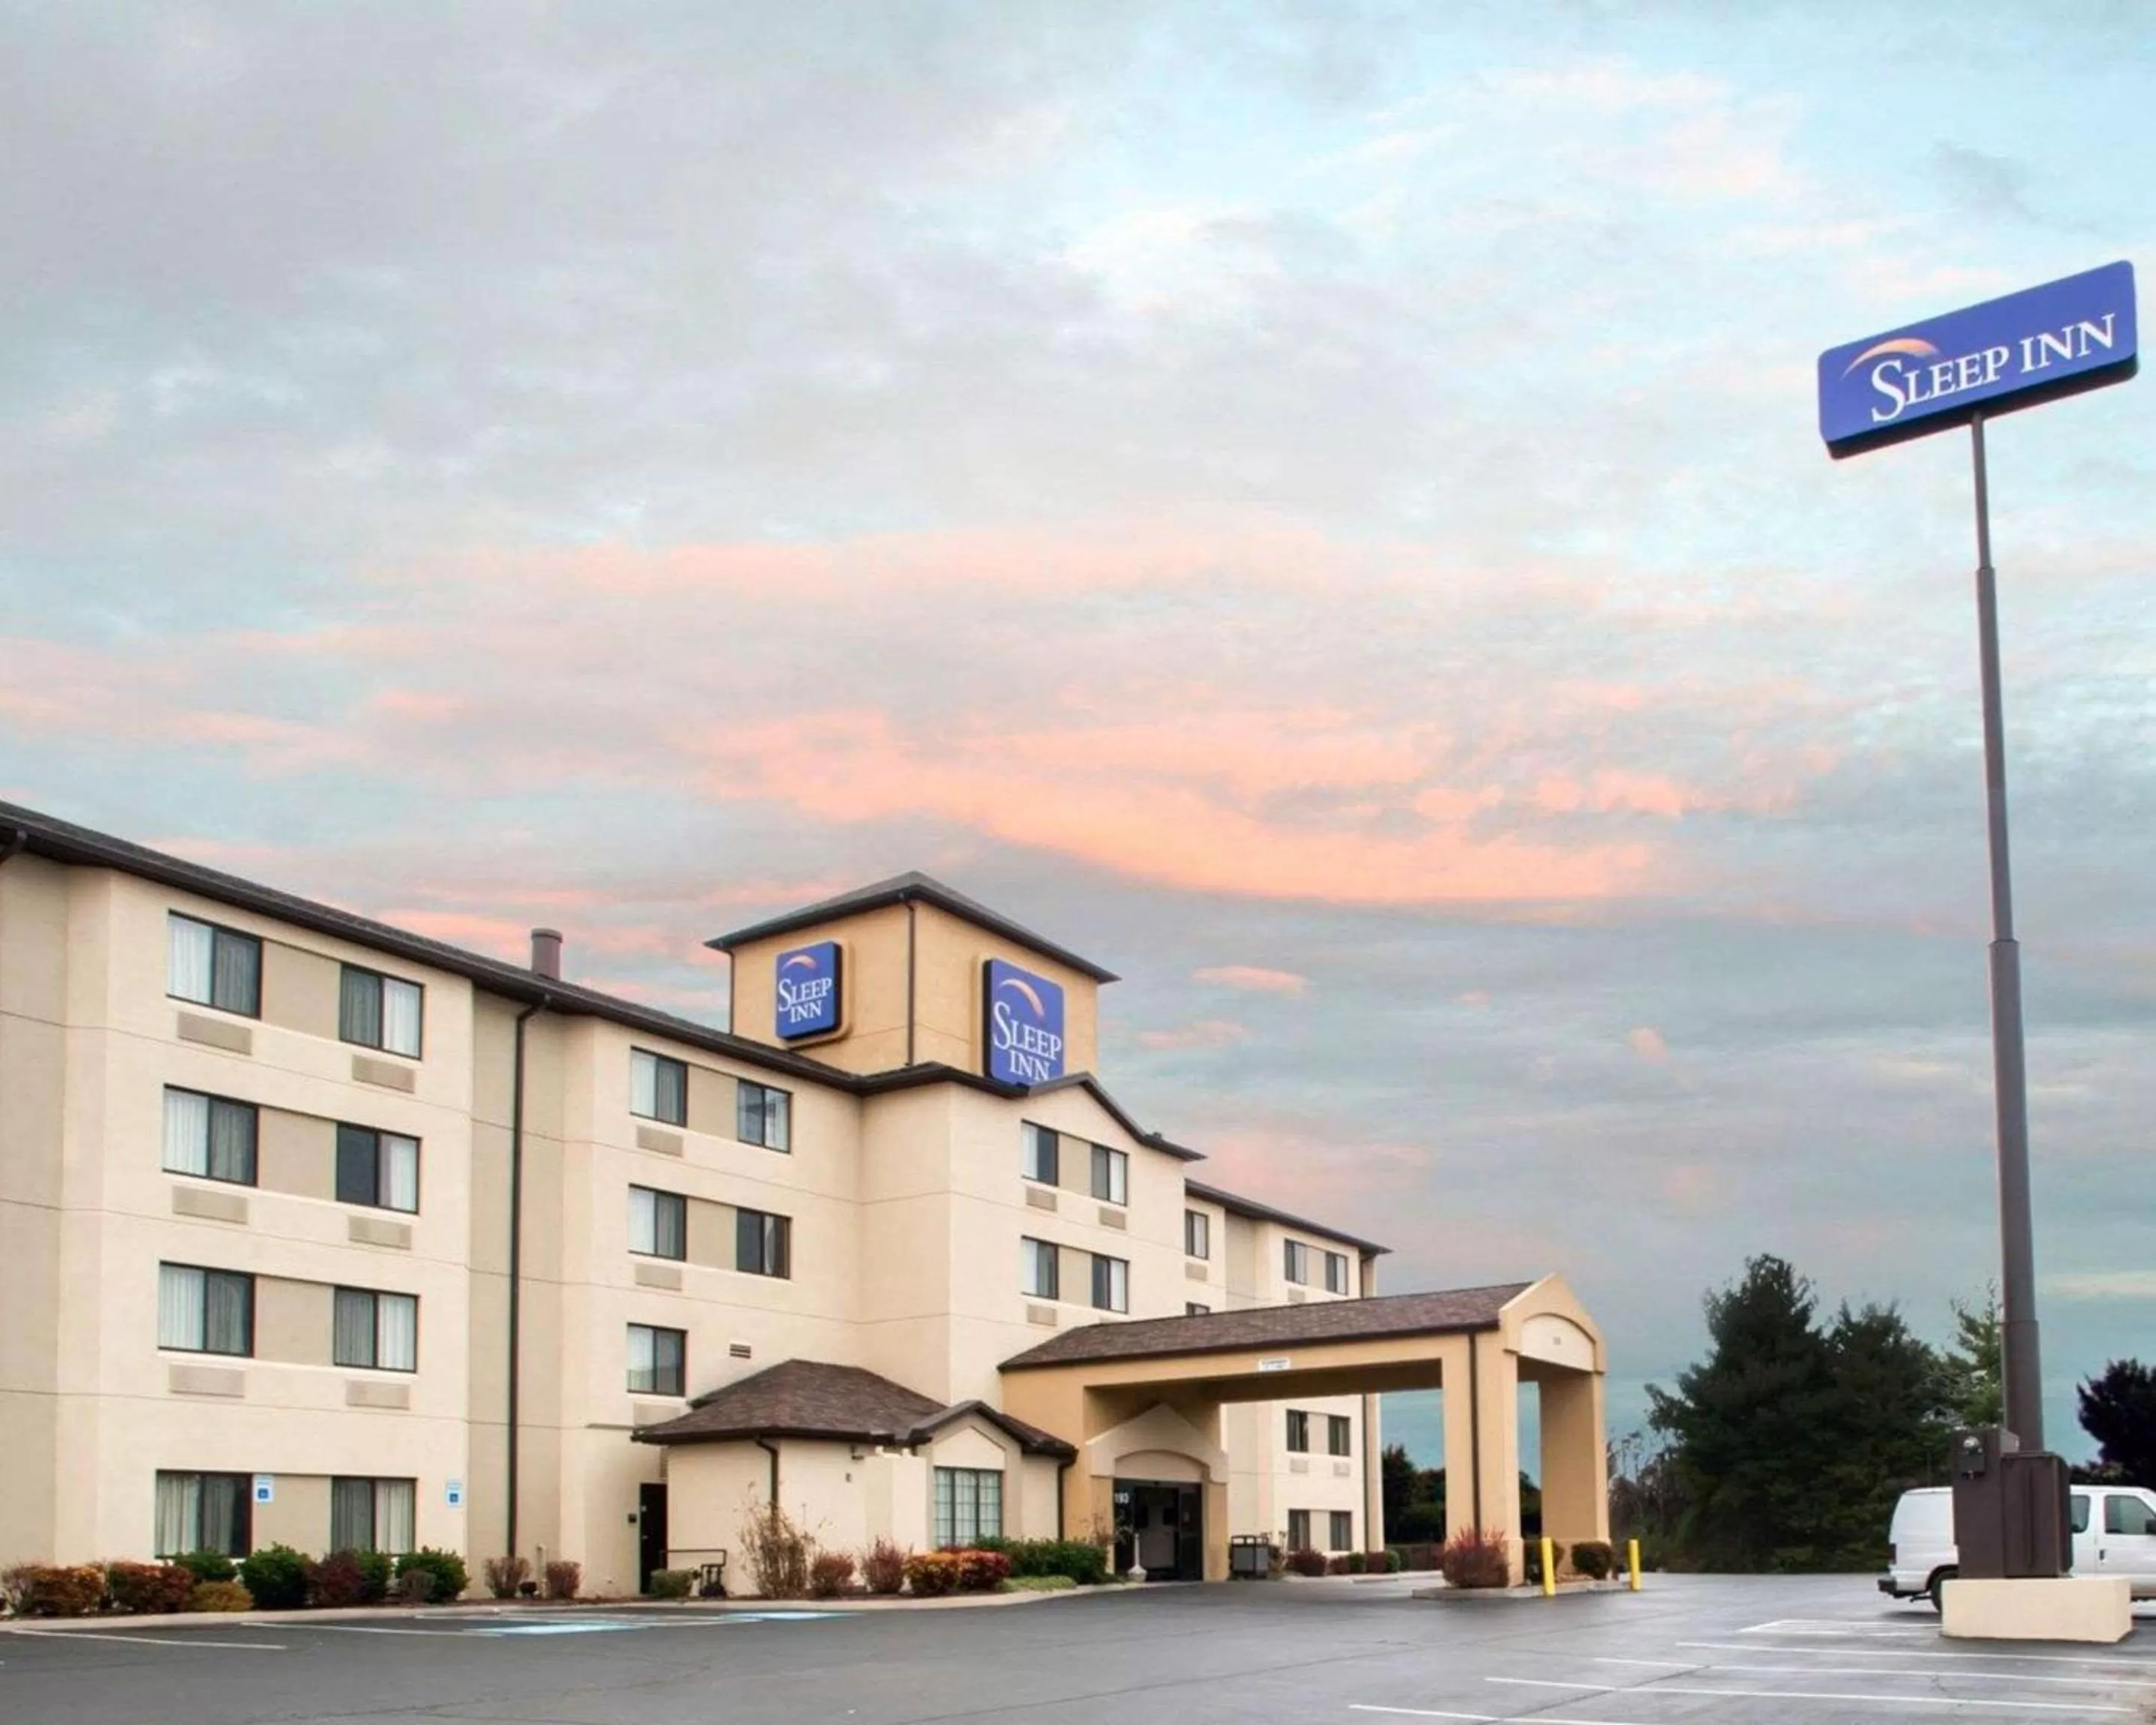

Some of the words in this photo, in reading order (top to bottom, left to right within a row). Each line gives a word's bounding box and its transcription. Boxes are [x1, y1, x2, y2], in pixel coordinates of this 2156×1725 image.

[1872, 345, 2009, 422] SLEEP
[2019, 314, 2116, 373] INN
[779, 978, 832, 1011] SLEEP
[790, 1000, 822, 1023] INN
[993, 1000, 1062, 1060] SLEEP
[1008, 1049, 1051, 1081] INN
